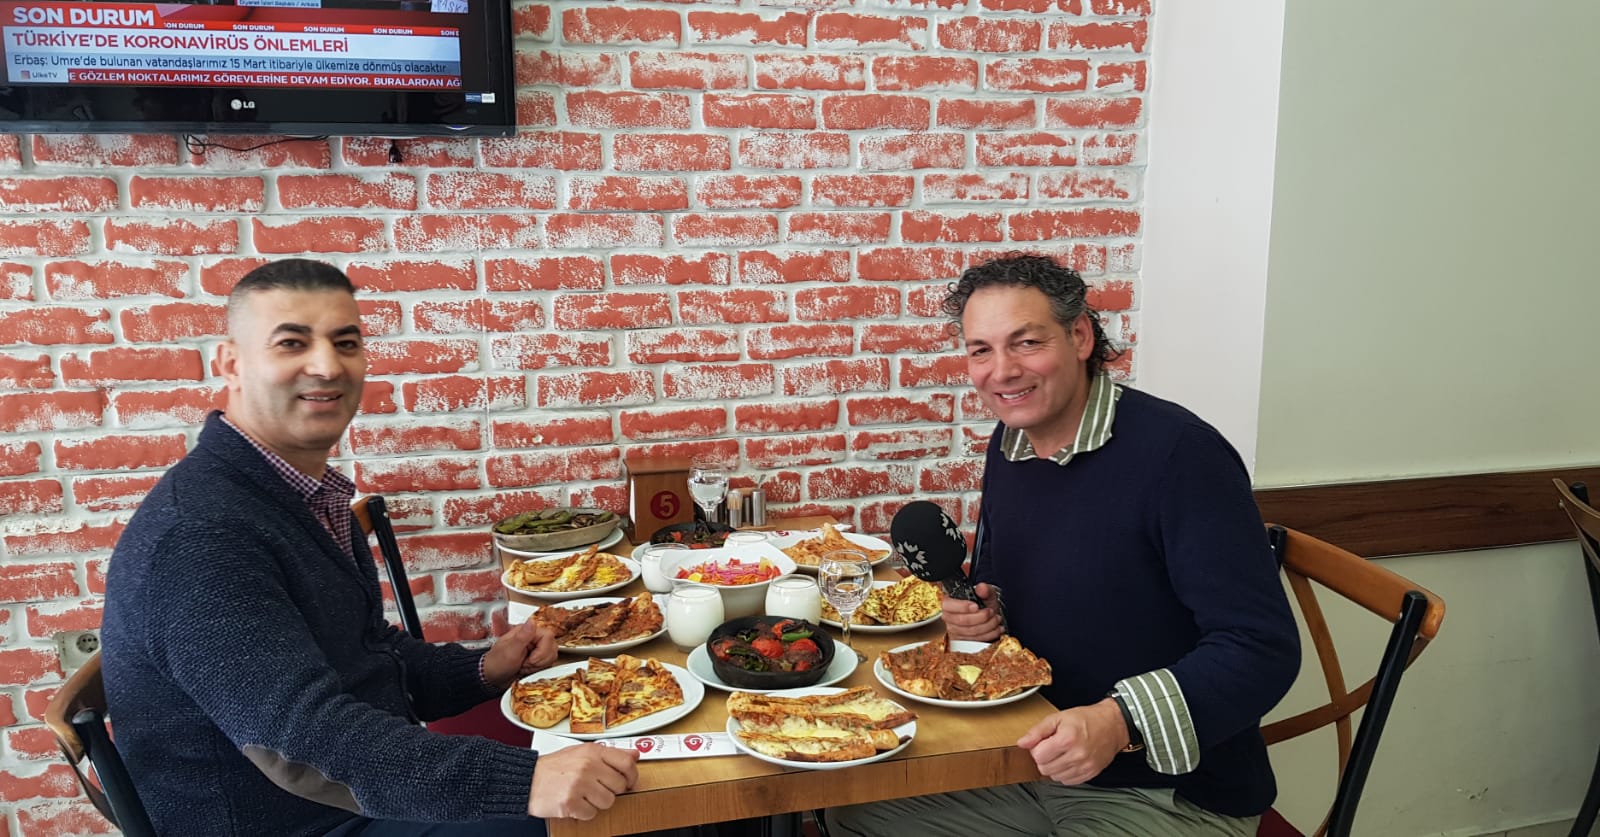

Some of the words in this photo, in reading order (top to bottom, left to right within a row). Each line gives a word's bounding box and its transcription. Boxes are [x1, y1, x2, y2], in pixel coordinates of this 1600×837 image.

[13, 6, 64, 25] SON
[69, 8, 155, 26] DURUM
[12, 29, 119, 48] TÜRKİYE'DE
[124, 33, 249, 51] KORONAVİRÜS
[254, 35, 349, 53] ÖNLEMLERİ
[14, 55, 48, 66] Erbaş:
[51, 55, 97, 66] Umre'de
[100, 56, 142, 67] bulunan
[145, 57, 228, 70] vatandaşlarımız
[230, 58, 240, 69] 15
[243, 59, 267, 69] Mart
[269, 59, 313, 72] itibariyle
[316, 60, 360, 72] ülkemize
[363, 61, 402, 73] dönmüş
[79, 70, 125, 81] GÖZLEM
[128, 72, 210, 83] NOKTALARIMIZ
[213, 72, 288, 85] GÖREVLERİNE
[290, 75, 328, 85] DEVAM
[330, 74, 372, 86] EDİYOR.
[373, 76, 444, 87] BURALARDAN
[243, 101, 255, 109] LG
[660, 494, 675, 517] 5
